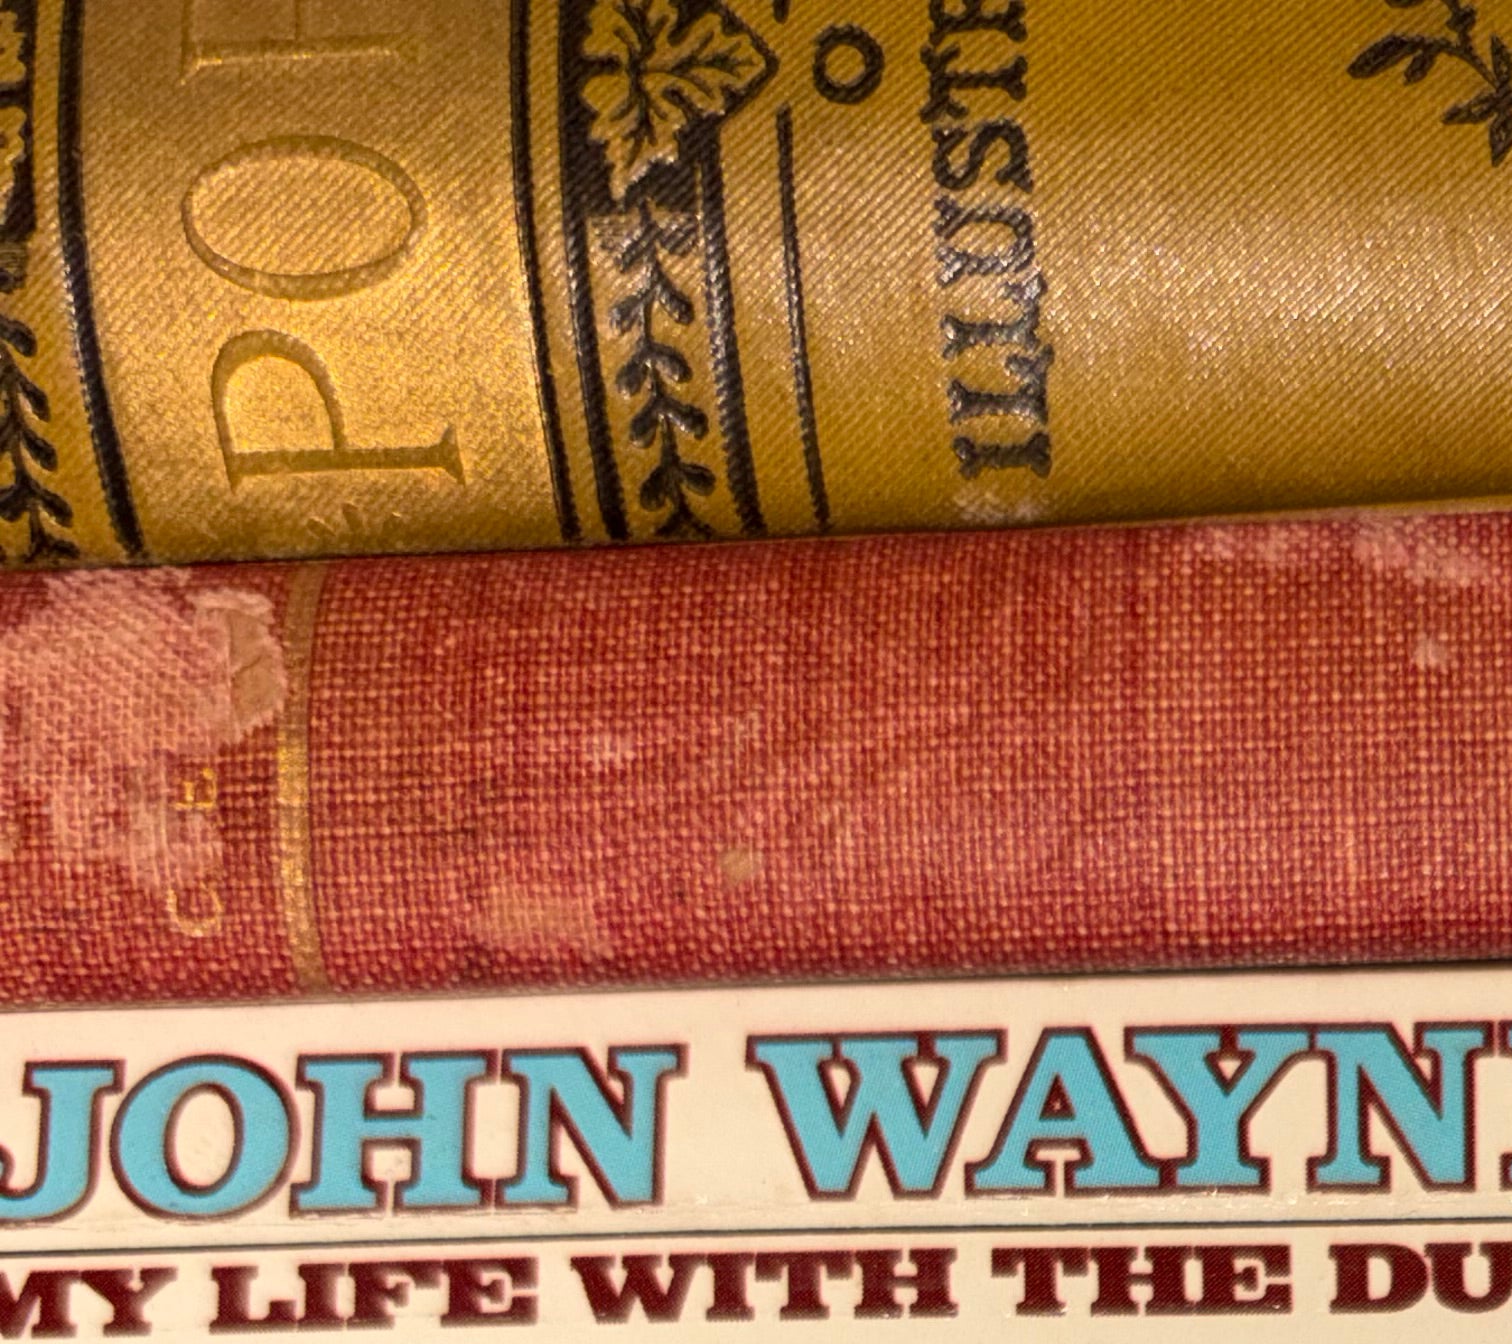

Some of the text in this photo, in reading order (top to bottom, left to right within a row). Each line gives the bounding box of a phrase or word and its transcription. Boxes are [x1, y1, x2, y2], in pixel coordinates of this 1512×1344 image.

[0, 1042, 690, 1228] JOHN
[0, 1266, 178, 1339] MY
[208, 1256, 539, 1335] LIFE
[571, 1247, 958, 1325] WITH
[991, 1243, 1293, 1318] THE
